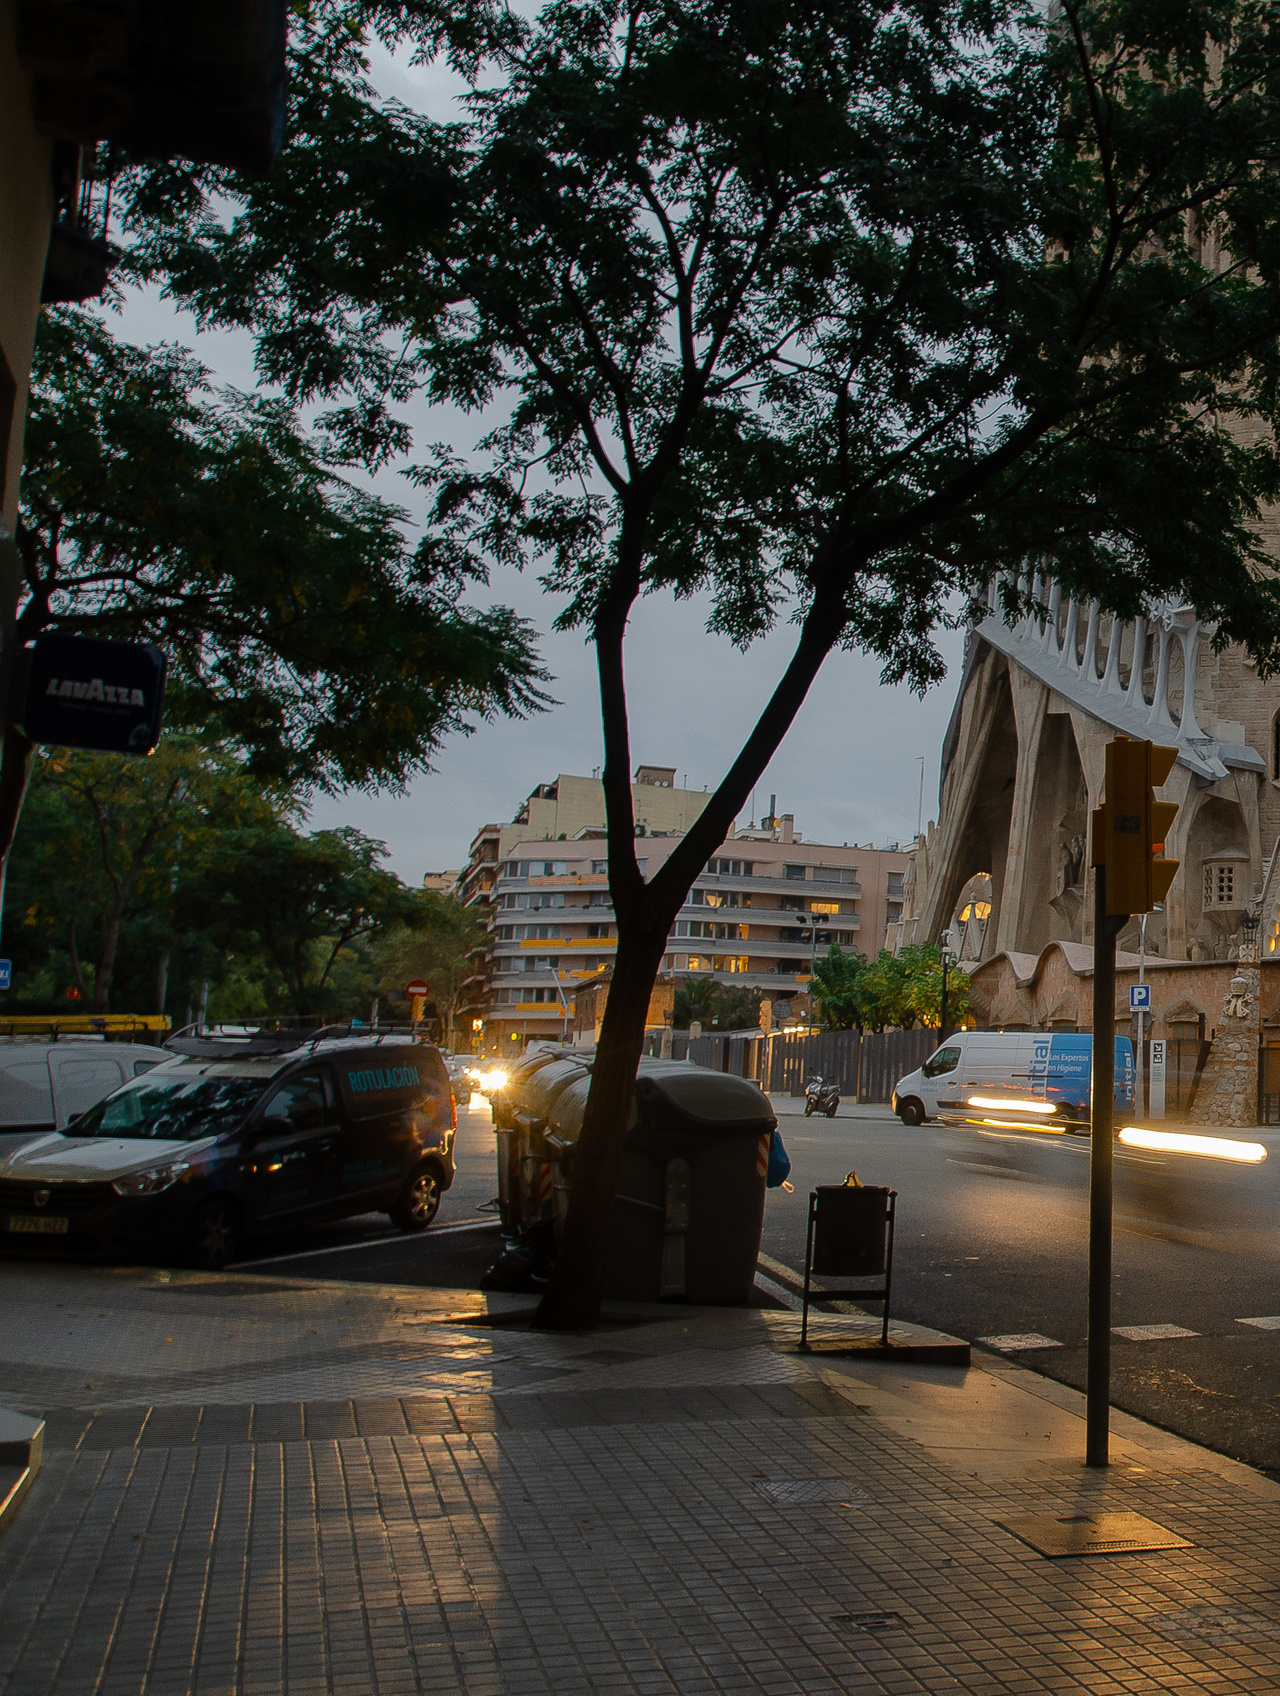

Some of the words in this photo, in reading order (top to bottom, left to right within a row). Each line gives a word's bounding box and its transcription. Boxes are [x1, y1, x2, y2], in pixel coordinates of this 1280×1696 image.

[45, 677, 145, 708] LAVAZZA
[1133, 988, 1147, 1005] P
[1061, 1054, 1089, 1062] Expertos
[348, 1062, 421, 1093] ROTULACIÓN
[1057, 1065, 1082, 1073] Higiene
